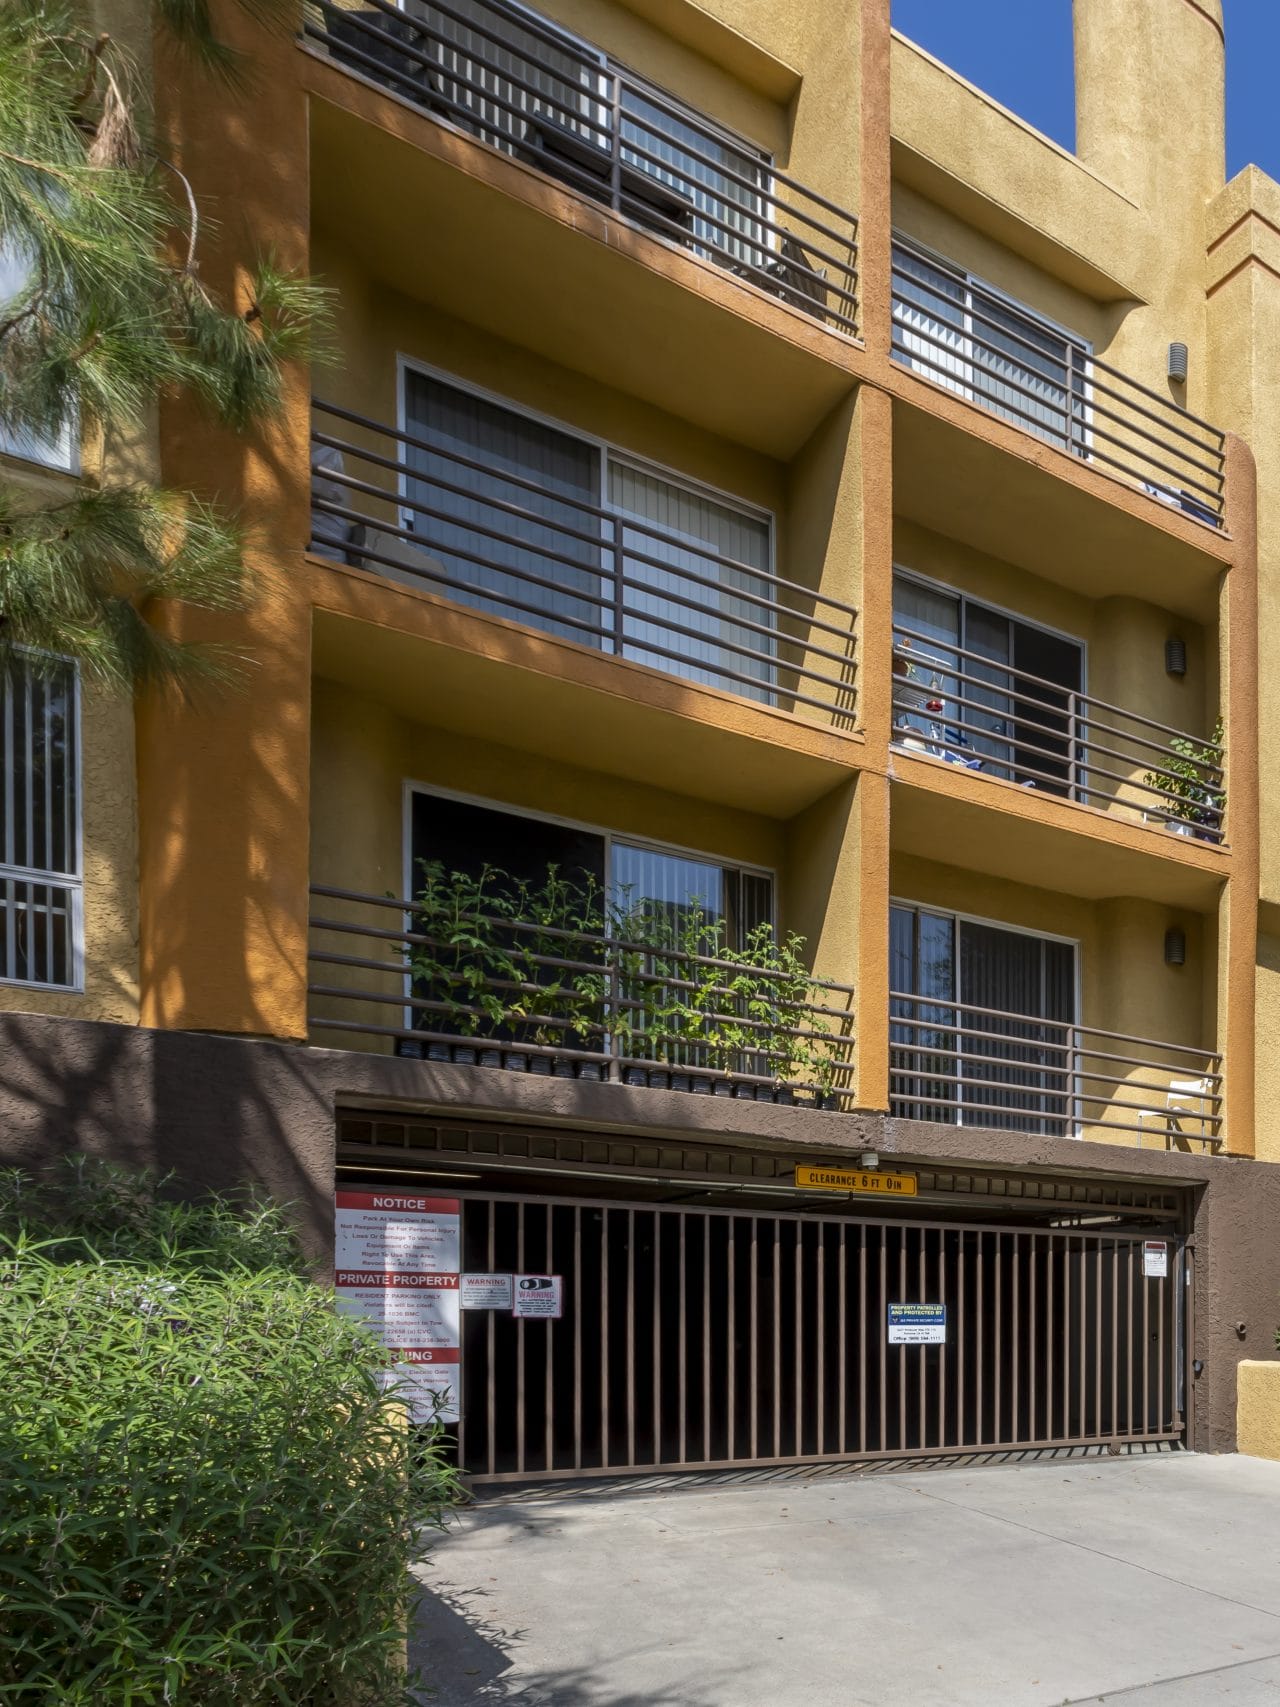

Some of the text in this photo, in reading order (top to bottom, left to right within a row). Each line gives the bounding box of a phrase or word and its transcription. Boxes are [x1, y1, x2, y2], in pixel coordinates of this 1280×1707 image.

[809, 1173, 857, 1186] CLEARANCE
[862, 1176, 868, 1187] 6
[871, 1179, 880, 1188] FT
[893, 1181, 902, 1190] IN
[373, 1197, 426, 1210] NOTICE
[354, 1224, 395, 1232] Responsible
[380, 1234, 406, 1242] Damage
[366, 1242, 402, 1250] Equipment
[362, 1251, 380, 1259] Right
[339, 1273, 457, 1286] PRIVATE PROPERTY
[467, 1278, 506, 1286] WARNING
[518, 1291, 555, 1299] WARNING
